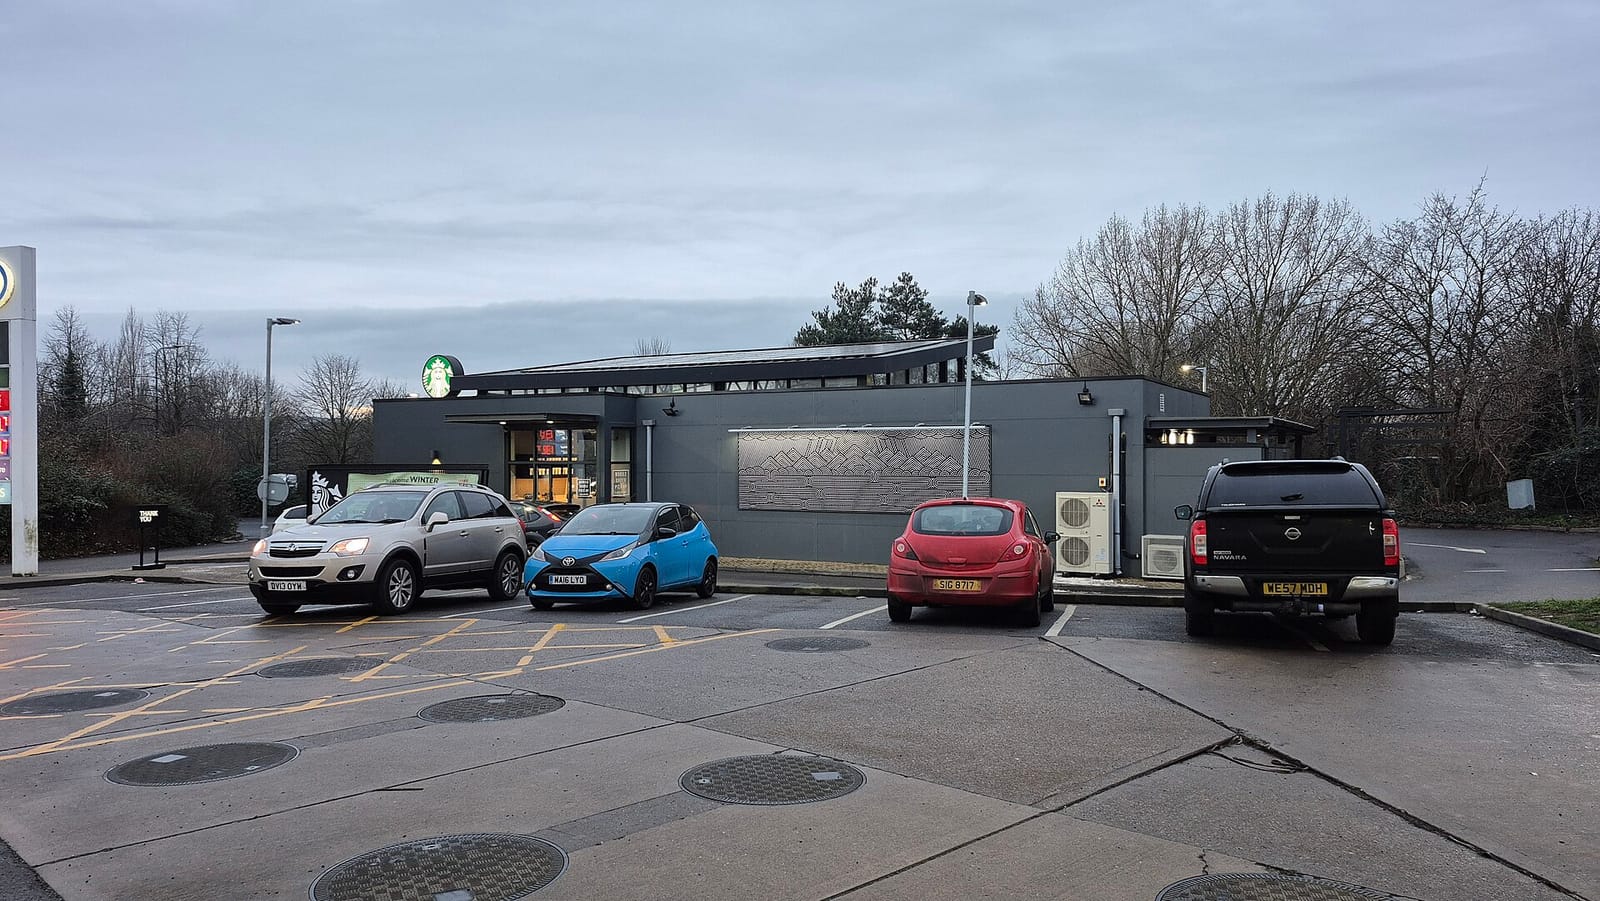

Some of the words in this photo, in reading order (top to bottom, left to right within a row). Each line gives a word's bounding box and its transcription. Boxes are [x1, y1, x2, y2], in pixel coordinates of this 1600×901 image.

[410, 476, 439, 484] WINTER
[939, 581, 953, 589] SIG
[955, 581, 975, 590] 8717
[1267, 583, 1297, 593] WE57
[1300, 583, 1323, 593] MDH
